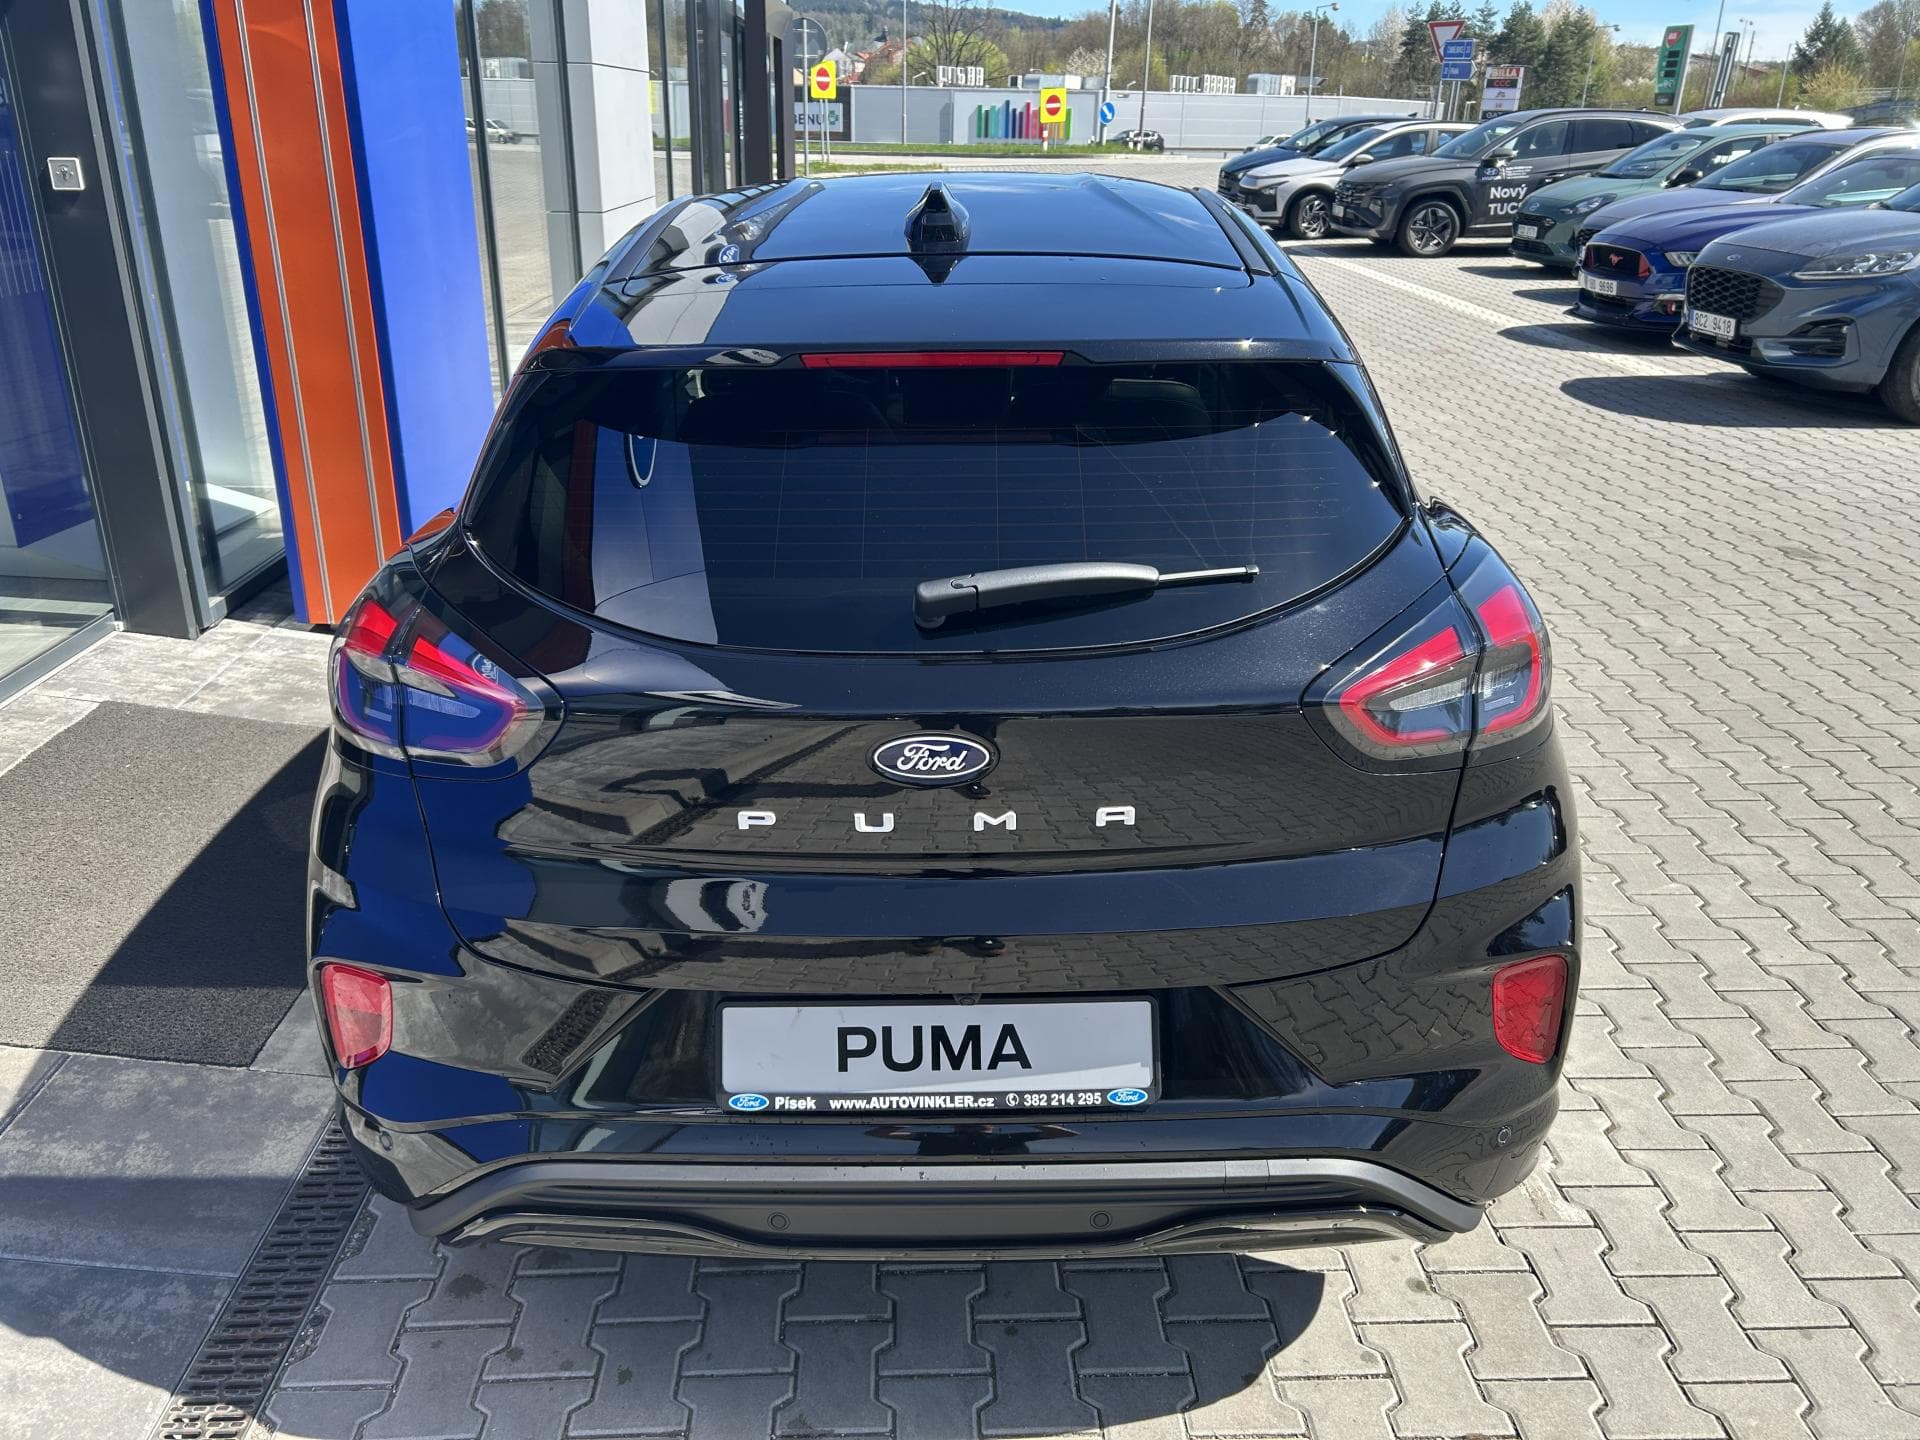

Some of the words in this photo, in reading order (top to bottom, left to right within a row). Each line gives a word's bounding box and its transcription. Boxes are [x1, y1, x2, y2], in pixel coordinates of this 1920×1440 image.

[1491, 67, 1517, 77] BILLA
[1494, 79, 1511, 87] CCC
[1489, 184, 1528, 200] Nový
[1488, 202, 1521, 216] TUC
[1694, 312, 1708, 329] 8C2
[1712, 317, 1732, 334] 9418
[896, 743, 968, 772] Ford
[737, 804, 1136, 833] PUMA
[836, 1023, 1033, 1073] PUMA
[774, 1095, 817, 1110] Písek
[829, 1094, 996, 1110] www.AUTOVINKLER.cz
[1024, 1093, 1048, 1106] 382
[1050, 1092, 1075, 1106] 214
[1077, 1091, 1102, 1105] 295
